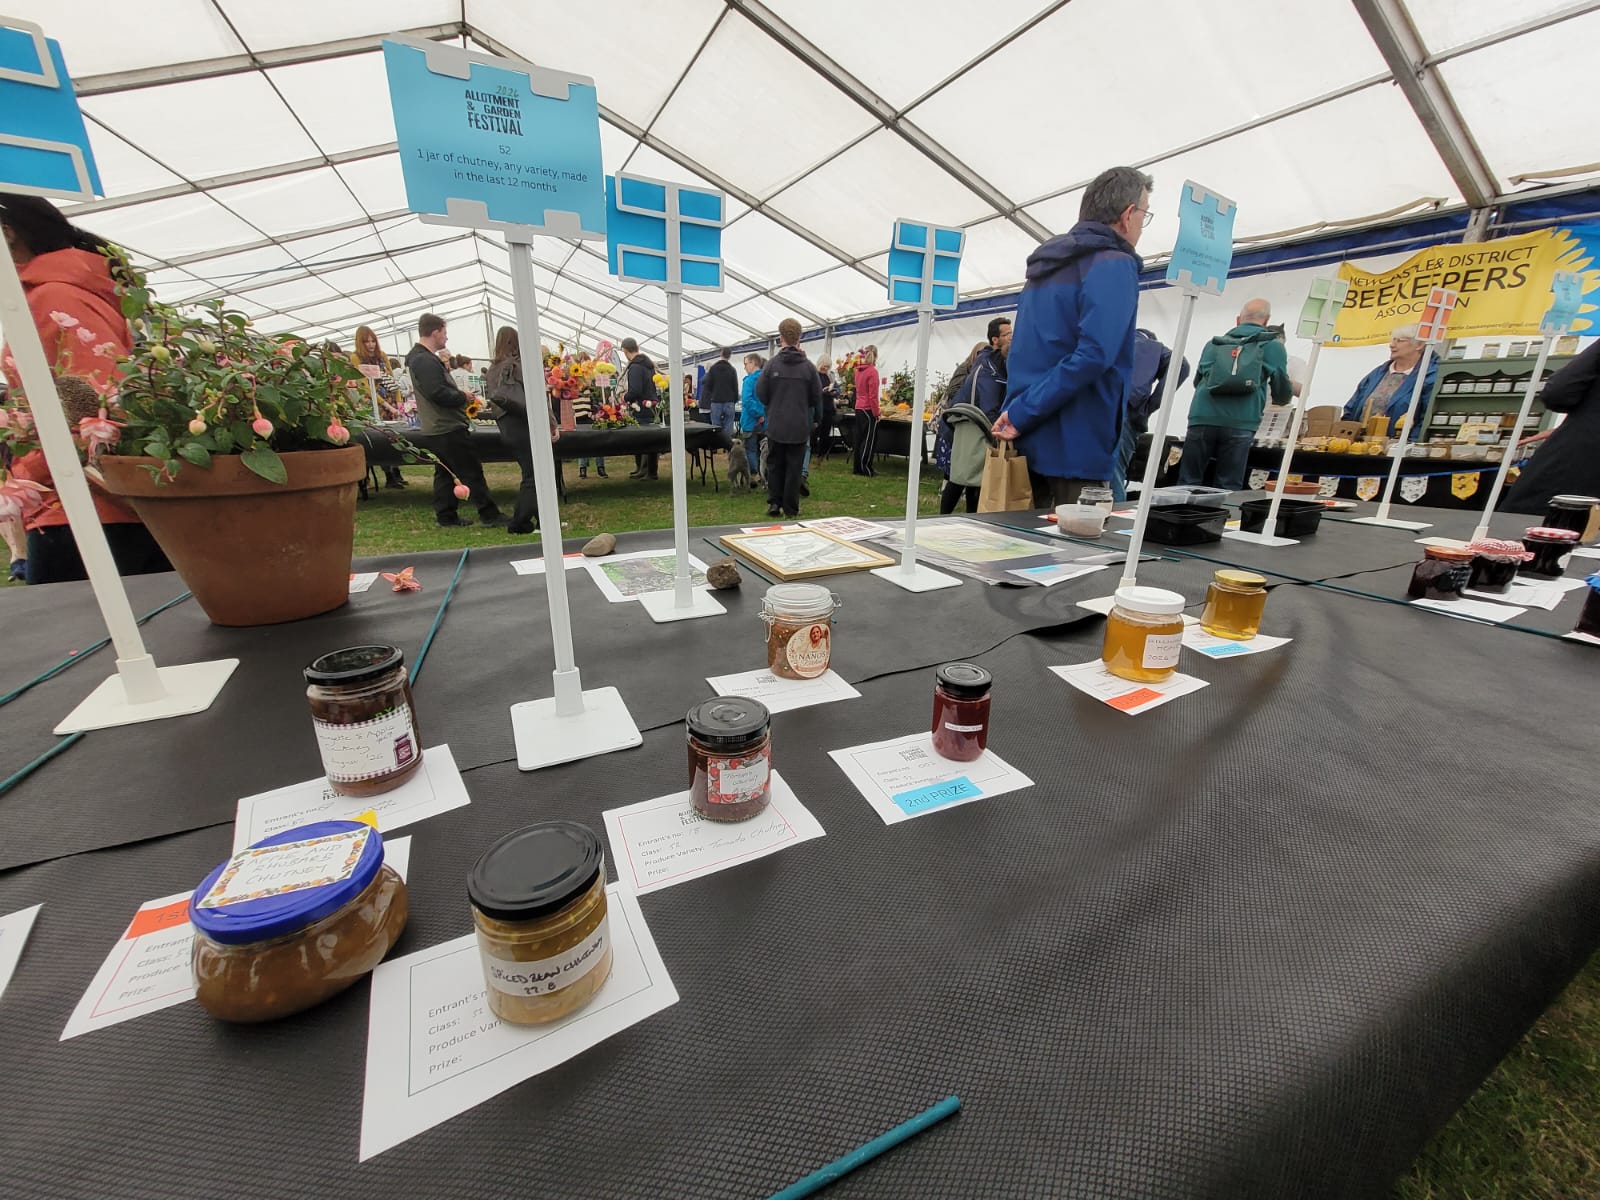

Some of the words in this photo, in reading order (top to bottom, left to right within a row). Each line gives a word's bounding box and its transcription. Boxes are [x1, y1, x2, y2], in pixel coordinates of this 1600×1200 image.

[465, 89, 519, 109] ALLOTMENT
[466, 101, 475, 111] &
[484, 104, 521, 120] GARDEN
[467, 111, 524, 137] FESTIVAL
[499, 145, 511, 155] 52
[417, 149, 424, 159] 1
[426, 151, 440, 162] jar
[443, 152, 454, 162] of
[457, 154, 502, 171] chutney,
[504, 162, 521, 174] any
[524, 166, 560, 180] variety,
[562, 172, 588, 183] made
[454, 169, 464, 180] in
[466, 171, 484, 183] the
[486, 174, 505, 186] last
[508, 177, 519, 187] 12
[521, 180, 557, 193] months
[1434, 257, 1445, 270] &
[1449, 245, 1539, 268] DISTRICT
[905, 794, 931, 809] 2nd
[930, 783, 968, 803] PRIZE
[145, 934, 195, 953] Entrant'
[128, 965, 181, 984] Produce
[118, 984, 158, 1000] Prize:
[428, 991, 479, 1018] Entrant's
[428, 1017, 461, 1036] Class:
[428, 1030, 477, 1054] Produce
[428, 1054, 463, 1075] Prize:
